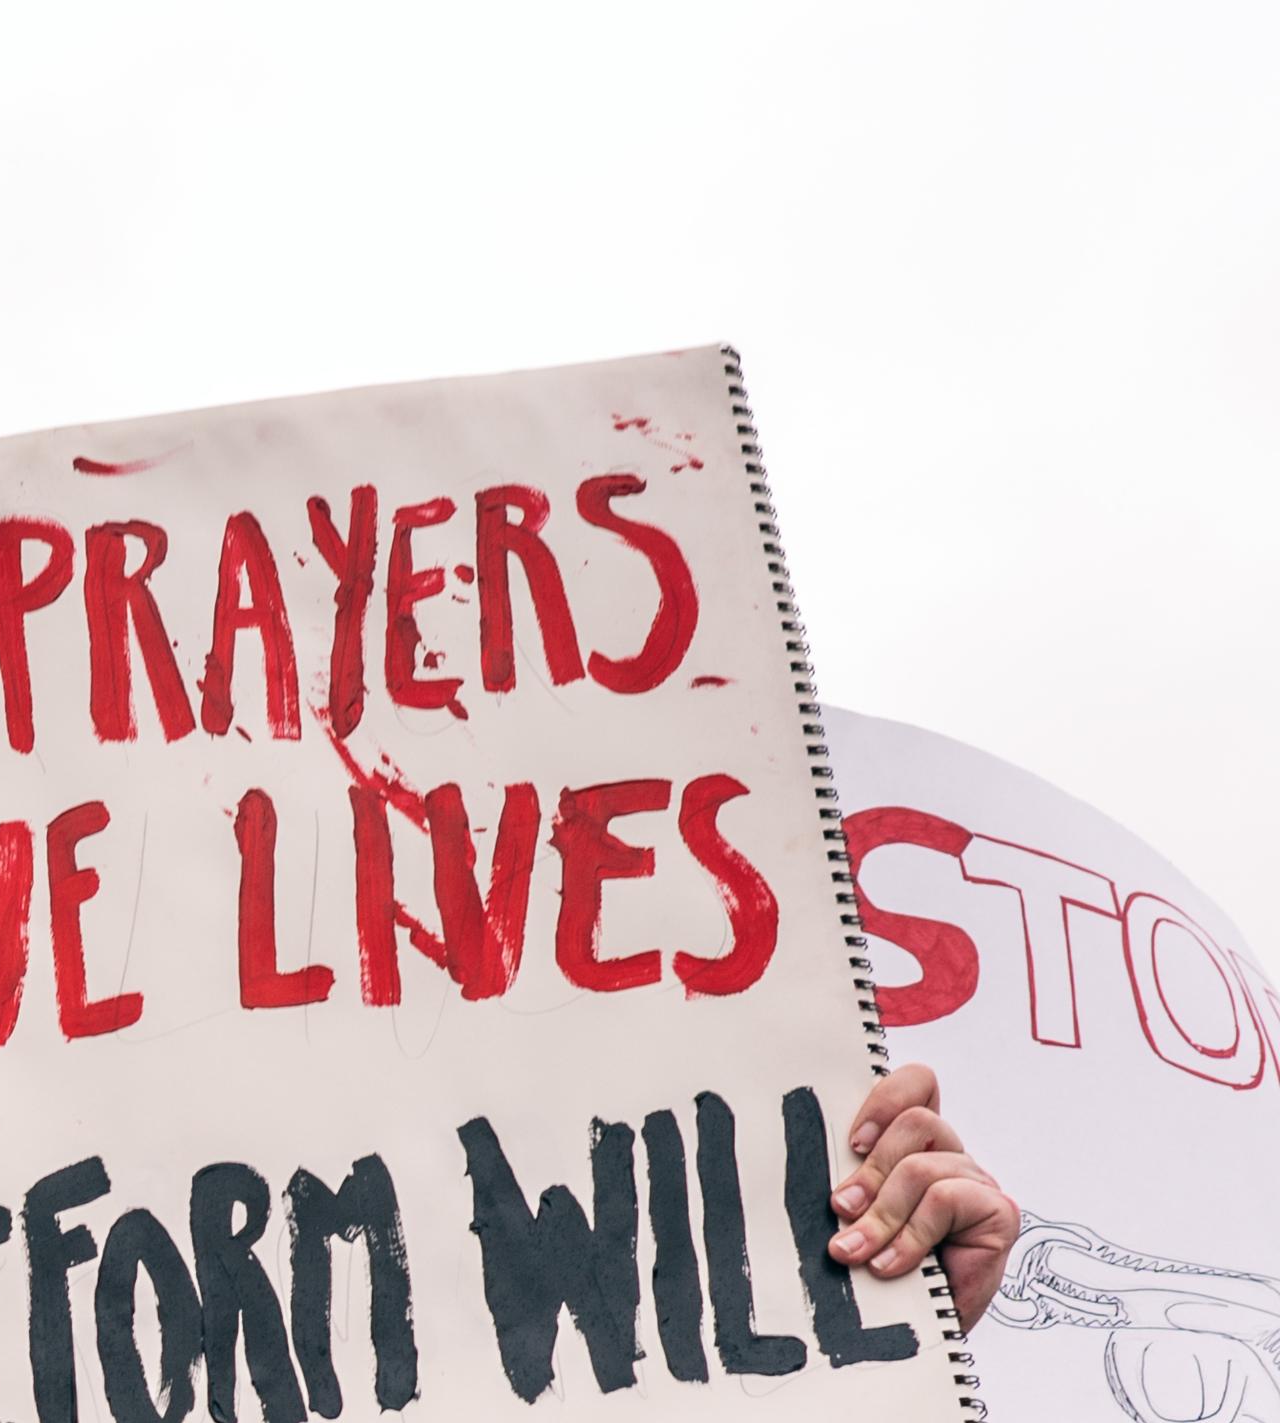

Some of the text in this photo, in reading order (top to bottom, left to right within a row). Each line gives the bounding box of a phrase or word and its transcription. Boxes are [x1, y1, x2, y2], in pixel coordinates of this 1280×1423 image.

[233, 772, 780, 1010] LIVES
[842, 805, 1280, 1091] STO
[455, 1085, 920, 1406] WILL
